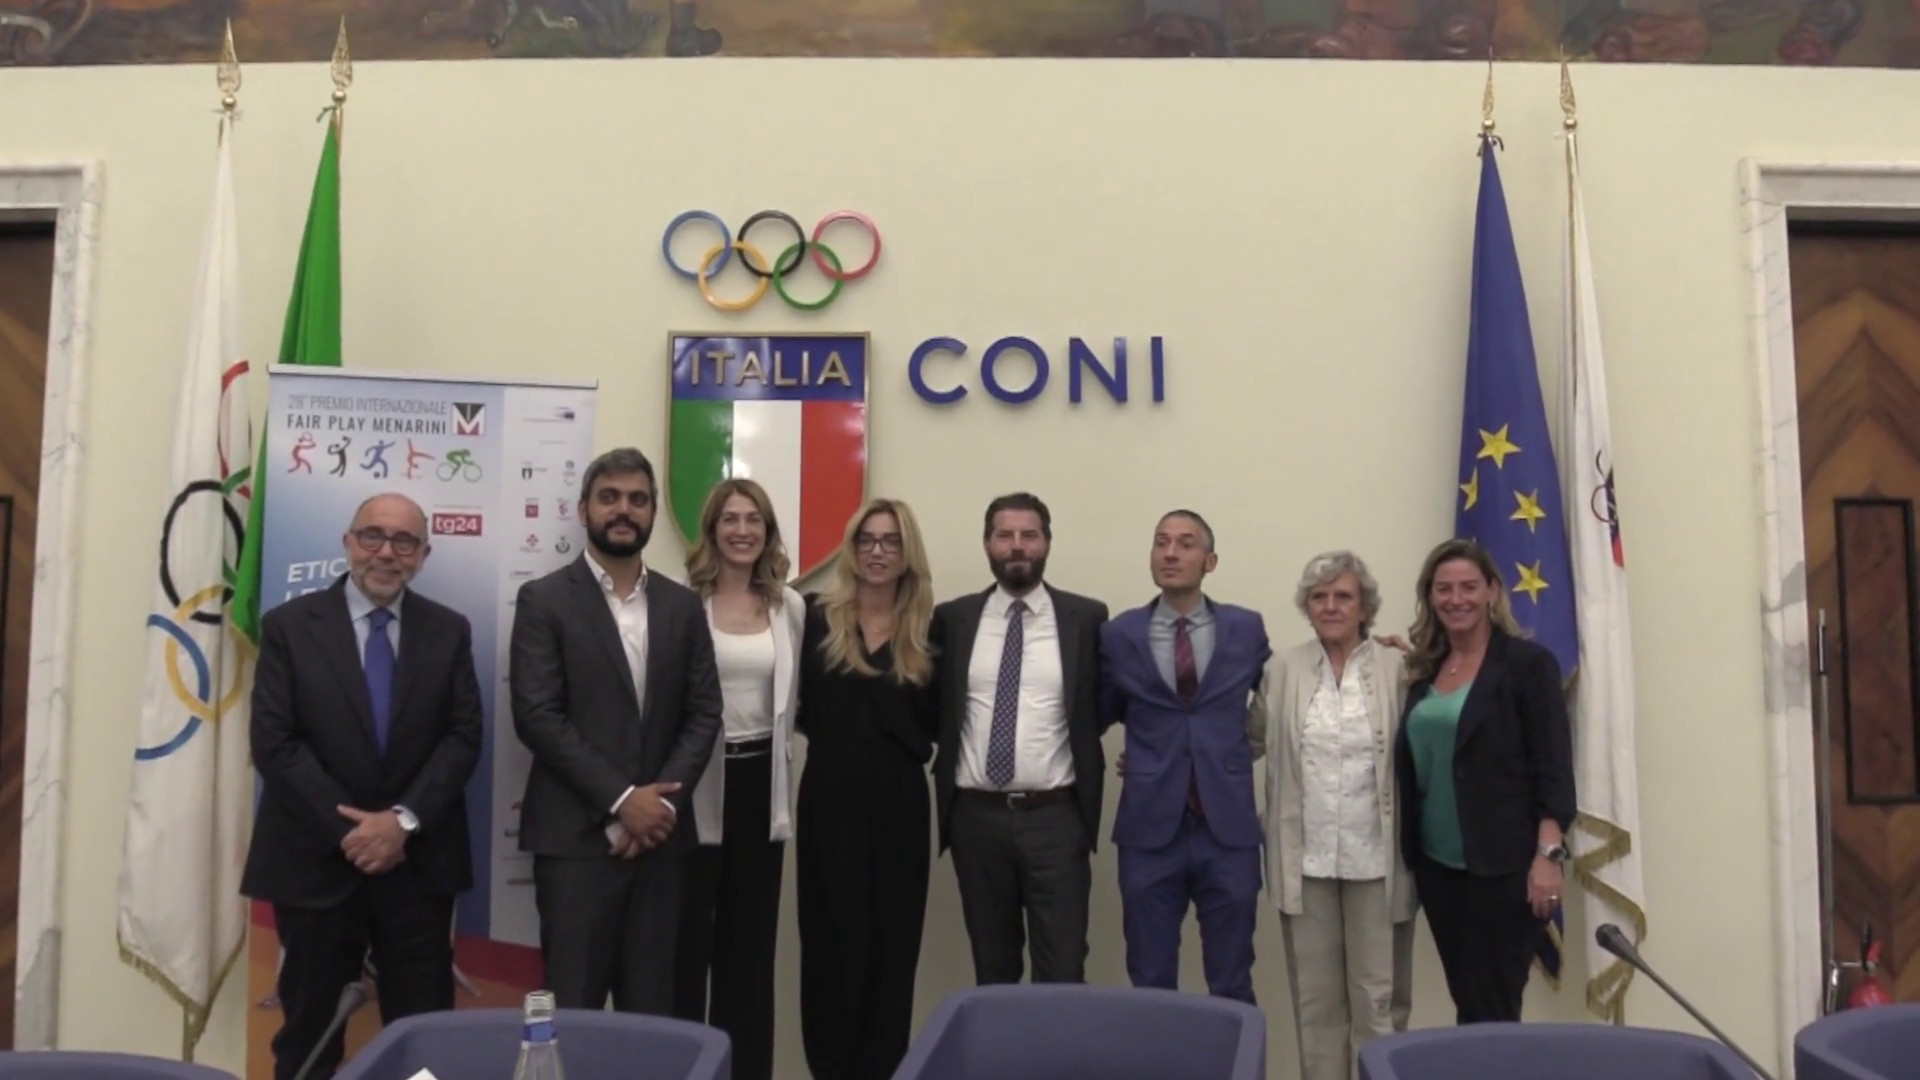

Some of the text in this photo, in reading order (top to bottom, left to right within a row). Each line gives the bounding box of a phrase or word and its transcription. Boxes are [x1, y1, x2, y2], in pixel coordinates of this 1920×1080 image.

[690, 350, 851, 387] ITALIA
[908, 336, 1164, 404] CONI
[310, 395, 354, 411] PREMIO
[356, 397, 447, 415] INTERNAZIONALE
[287, 413, 446, 435] FAIR PLAY MENARINI
[436, 516, 478, 534] tg24
[287, 557, 352, 583] ETIC
